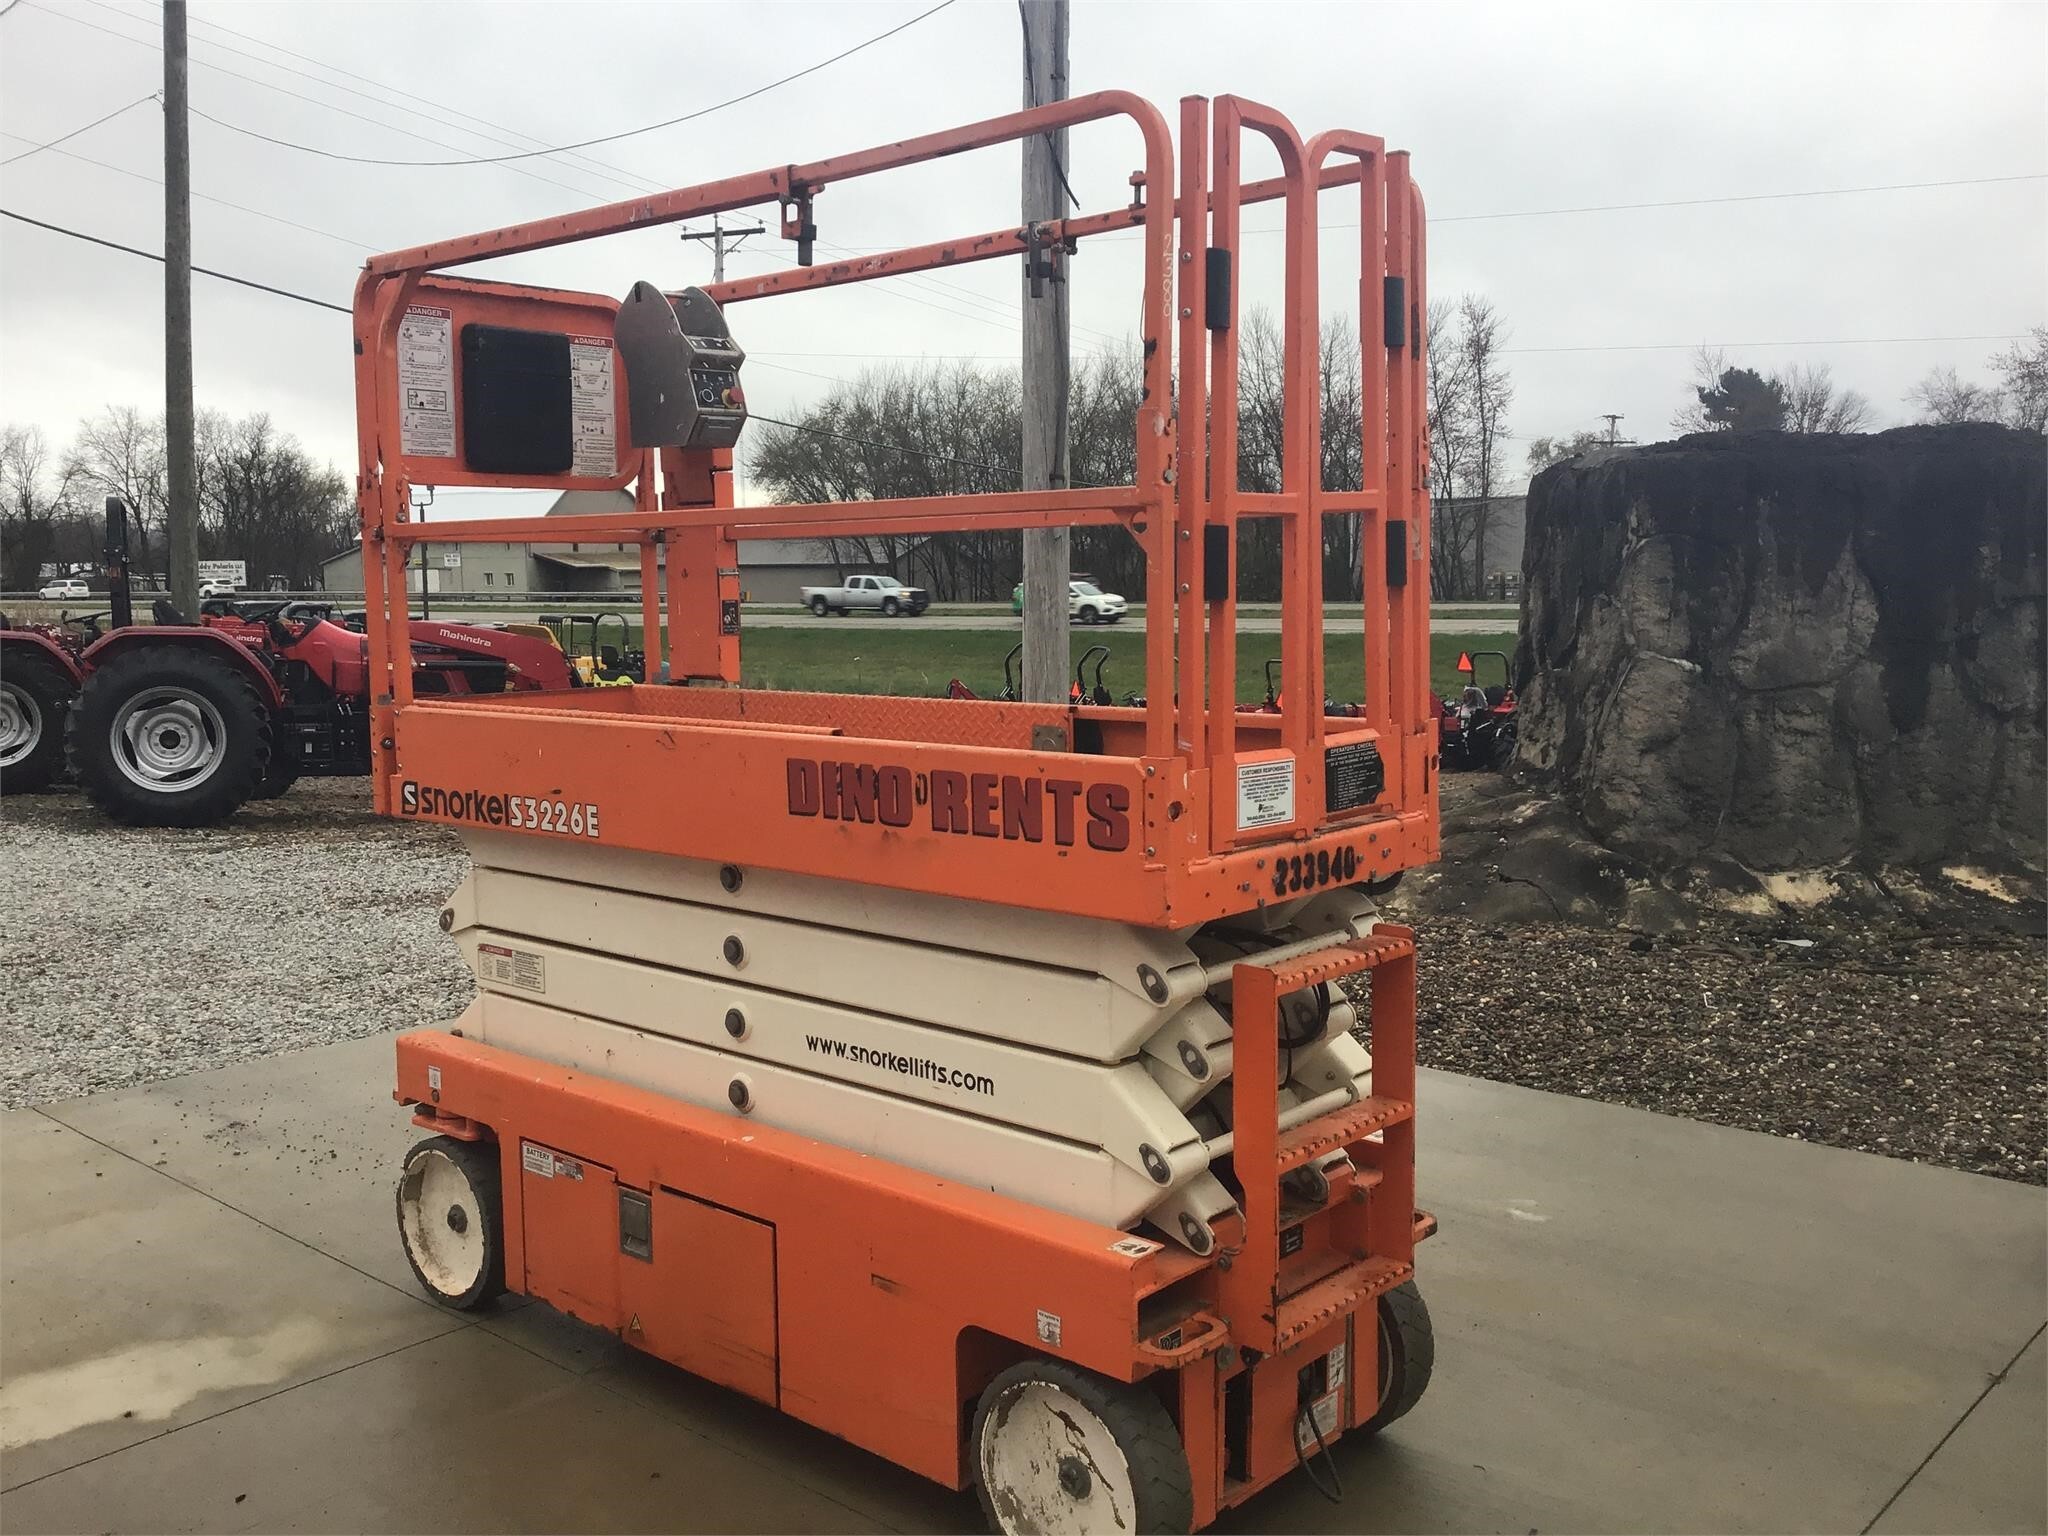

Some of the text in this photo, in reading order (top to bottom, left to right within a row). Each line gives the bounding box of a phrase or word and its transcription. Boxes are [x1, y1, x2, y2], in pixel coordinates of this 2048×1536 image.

[412, 308, 442, 317] DANGER
[579, 338, 606, 346] DANGER
[236, 634, 263, 643] indra
[1241, 768, 1262, 776] CUSTOMER
[787, 758, 1130, 852] DINO RENTS
[421, 786, 510, 827] snorkel
[509, 795, 600, 837] S3226E
[806, 1034, 995, 1096] www.snorkellifts.com
[526, 1147, 550, 1160] BATTERY
